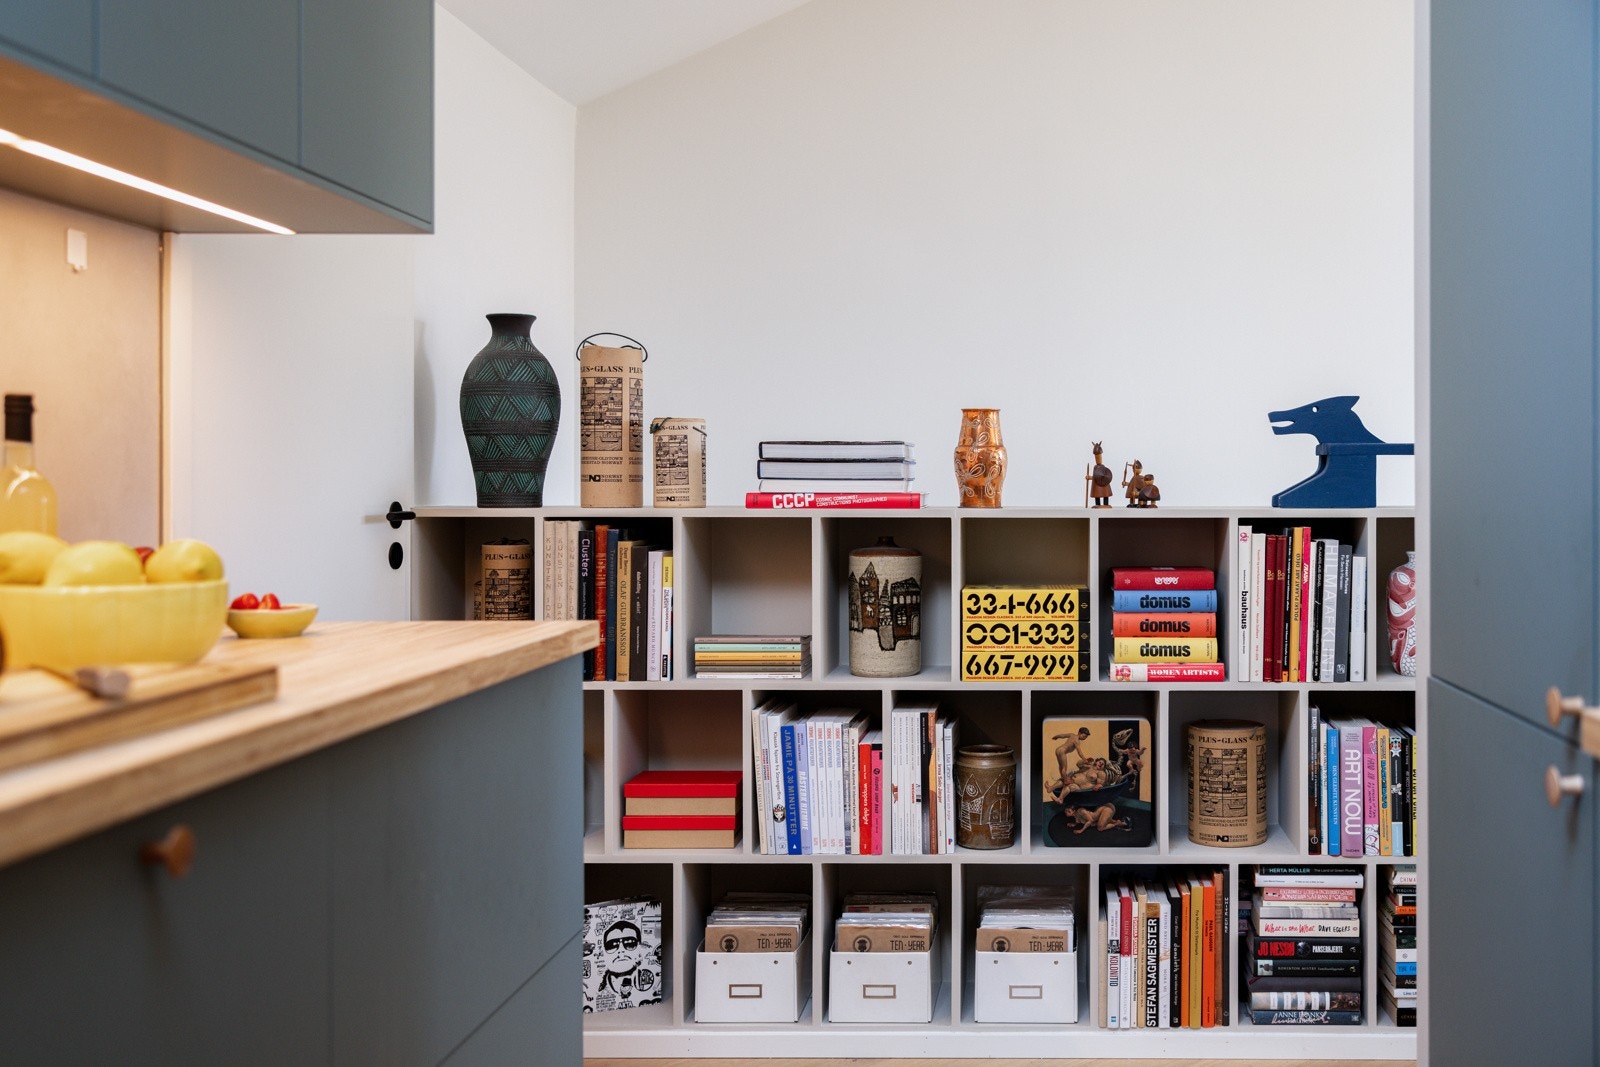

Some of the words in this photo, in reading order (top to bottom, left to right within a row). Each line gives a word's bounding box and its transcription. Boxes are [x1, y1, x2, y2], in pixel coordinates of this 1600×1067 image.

[771, 493, 817, 509] CCCP
[581, 538, 590, 577] Clusters
[1323, 545, 1338, 601] HILMA
[966, 593, 1075, 616] 334-666
[1140, 595, 1191, 608] domus
[1241, 590, 1249, 630] bauhaus
[1140, 619, 1191, 633] domus
[1324, 605, 1336, 624] AF
[619, 602, 627, 657] GULBRANSSON
[966, 623, 1075, 646] 001-333
[1140, 643, 1191, 657] domus
[1322, 626, 1335, 677] KLINT
[966, 654, 1076, 676] 667-999
[1149, 668, 1180, 676] WOMEN
[1180, 668, 1220, 676] ARTISTS
[784, 729, 792, 758] JAMIE
[786, 759, 794, 773] PÅ
[1344, 749, 1361, 785] ART
[787, 775, 793, 784] 30
[788, 786, 797, 836] MINUTTER
[1344, 789, 1361, 835] NOW
[1264, 922, 1281, 933] What
[1298, 922, 1315, 933] What
[1146, 918, 1157, 986] SAGMEISTER
[1258, 941, 1269, 956] JO
[1146, 987, 1157, 1027] STEFAN
